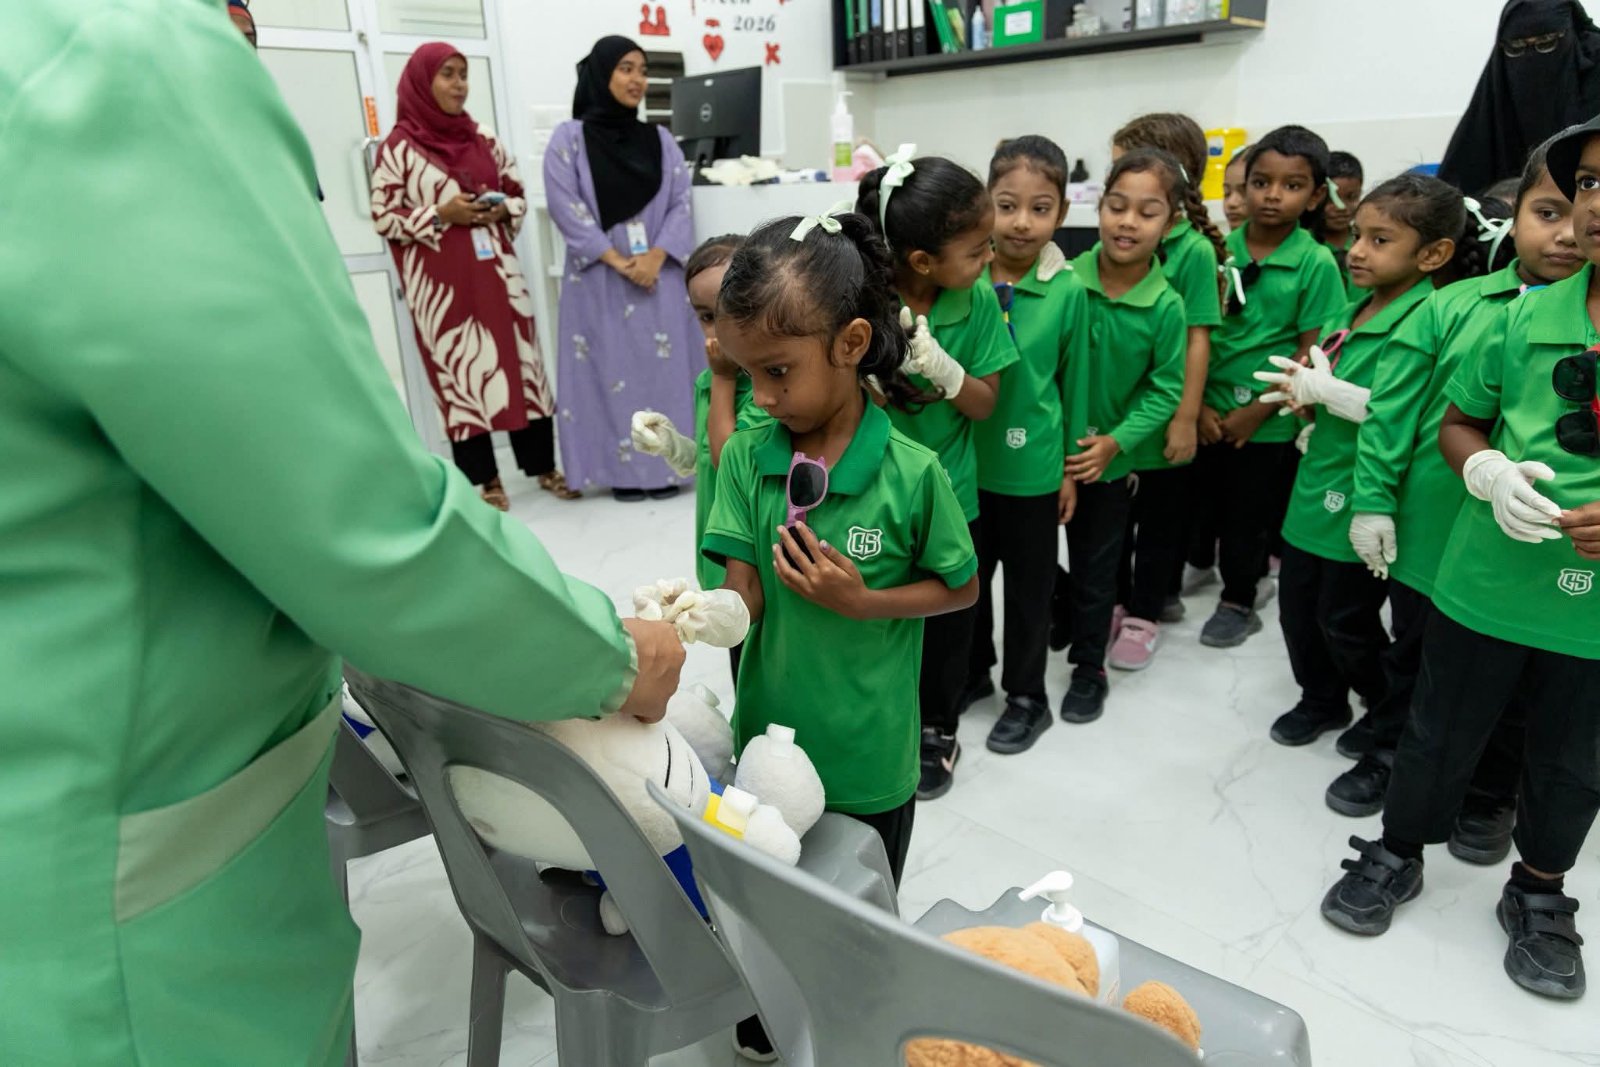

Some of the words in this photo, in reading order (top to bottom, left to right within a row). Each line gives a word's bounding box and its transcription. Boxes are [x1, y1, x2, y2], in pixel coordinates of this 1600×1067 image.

[733, 15, 776, 32] 2026
[851, 532, 877, 555] GS
[1562, 572, 1589, 591] GS
